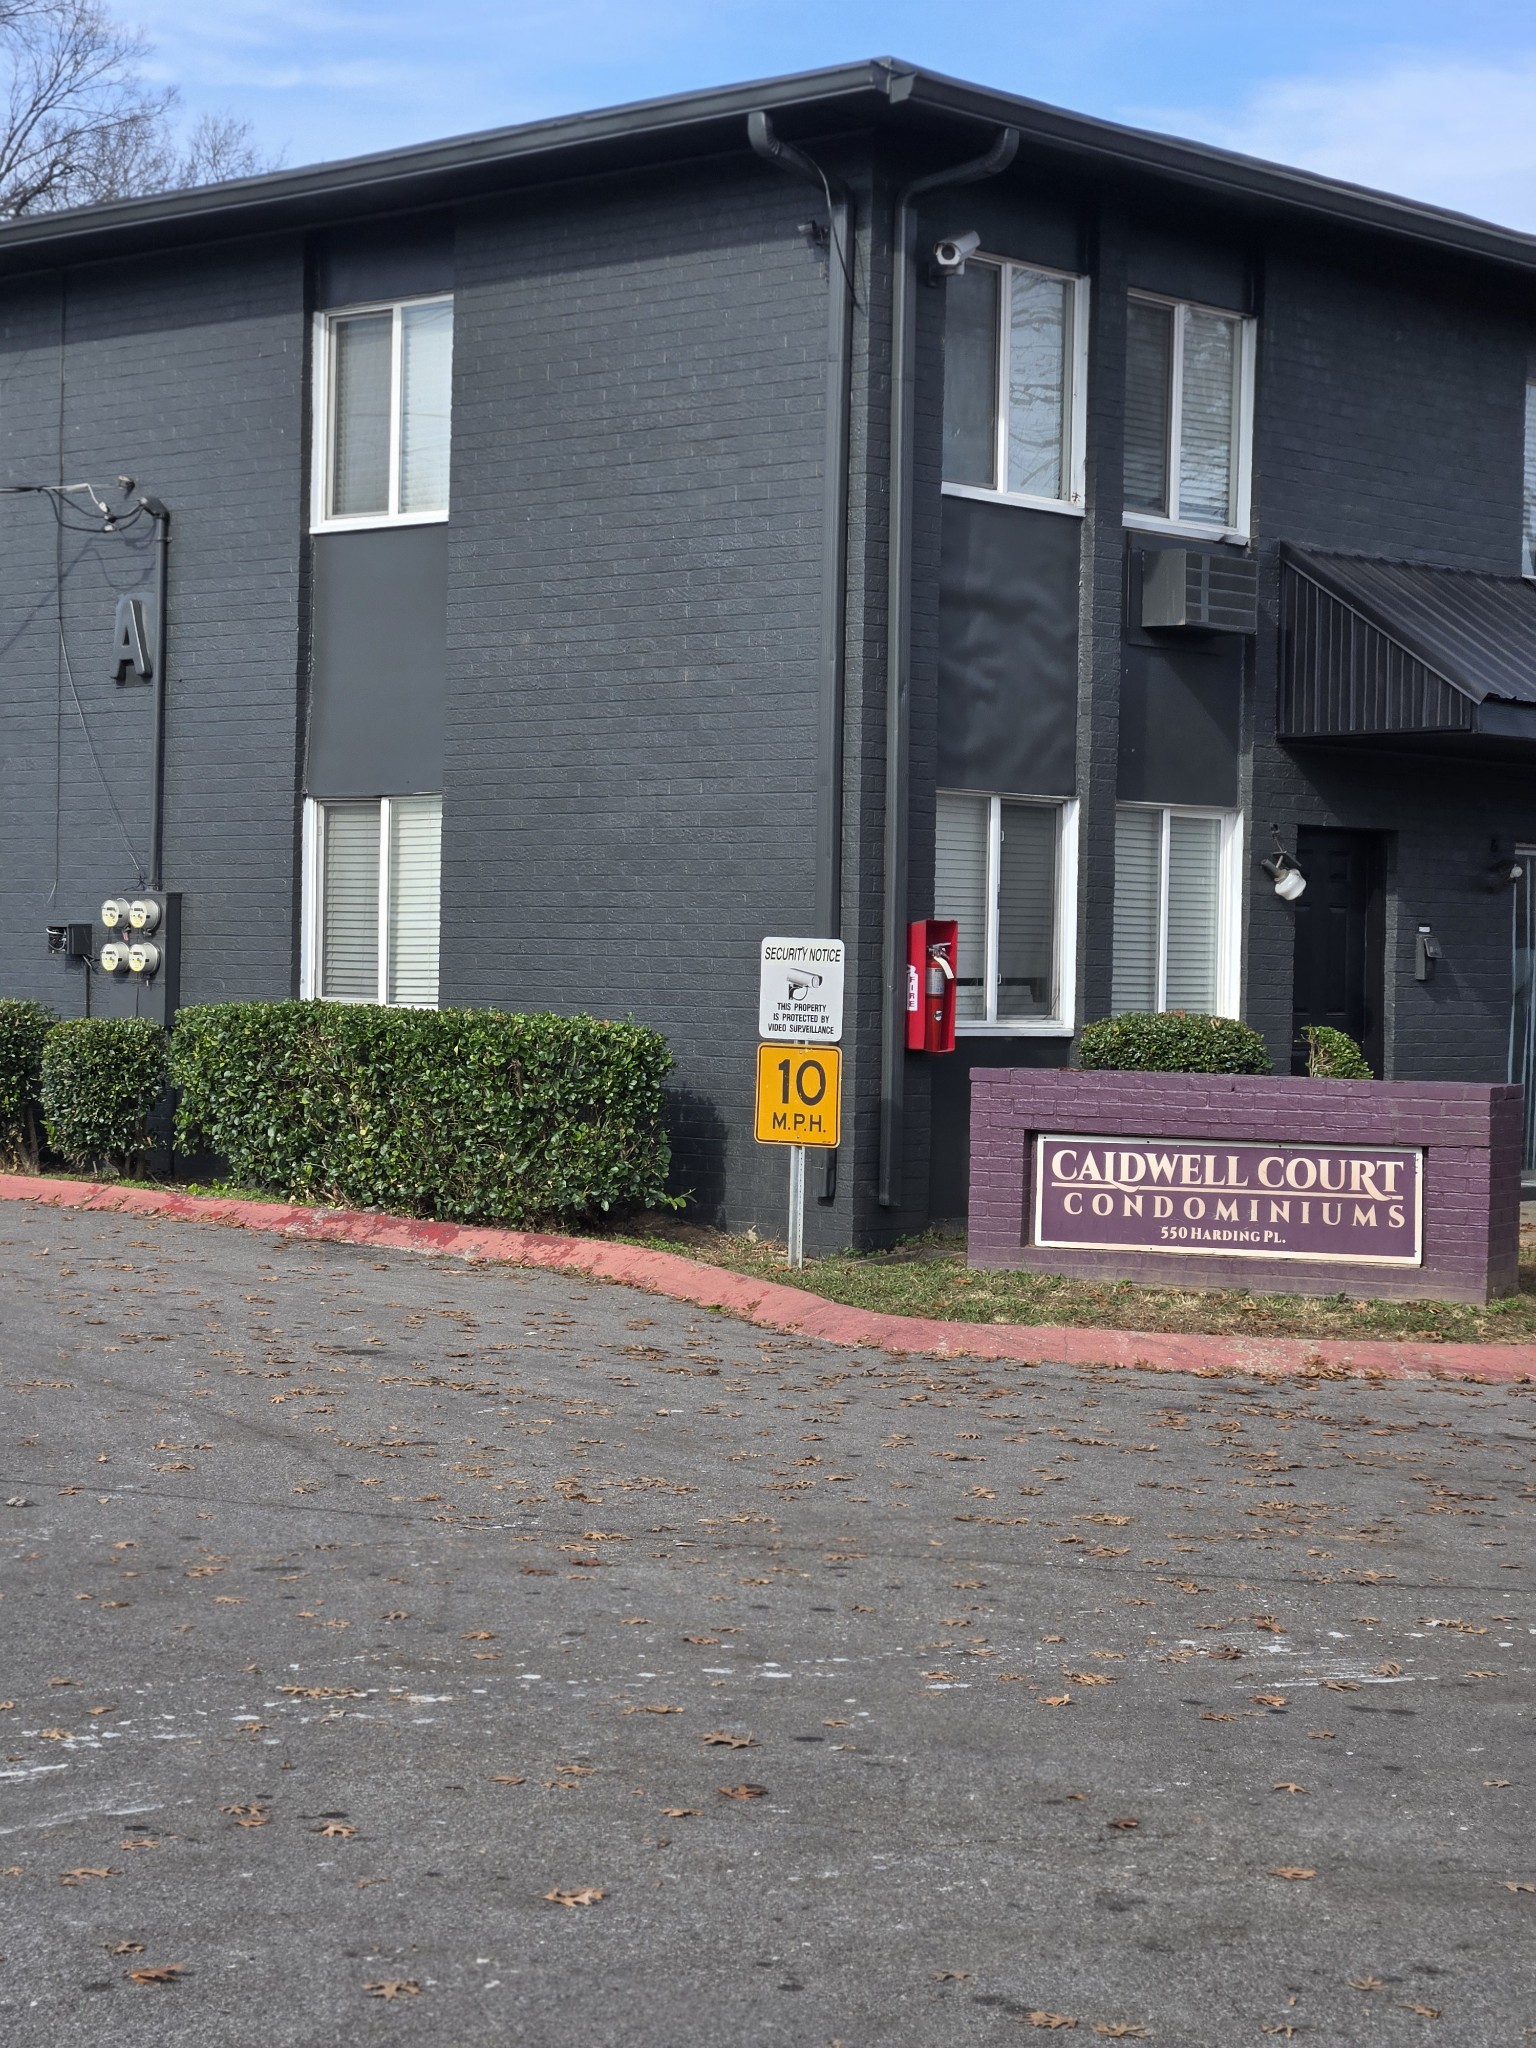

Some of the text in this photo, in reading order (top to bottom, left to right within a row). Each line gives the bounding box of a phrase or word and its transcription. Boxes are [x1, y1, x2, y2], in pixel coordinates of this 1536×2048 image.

[111, 597, 151, 679] A
[765, 946, 842, 963] SECURITY NOTICE
[908, 976, 916, 1008] FIRE
[773, 1013, 830, 1024] IS PROTECTED BY
[777, 1002, 827, 1013] THIS PROPERTY
[768, 1023, 834, 1035] VIDEO SURVEILLANCE
[778, 1058, 827, 1106] 10
[772, 1111, 827, 1133] M.P.H.
[1051, 1149, 1404, 1202] CALDWELL COURT
[1063, 1192, 1406, 1229] CONDOMINIUMS
[1160, 1226, 1188, 1240] 550
[1190, 1227, 1261, 1243] HARDING
